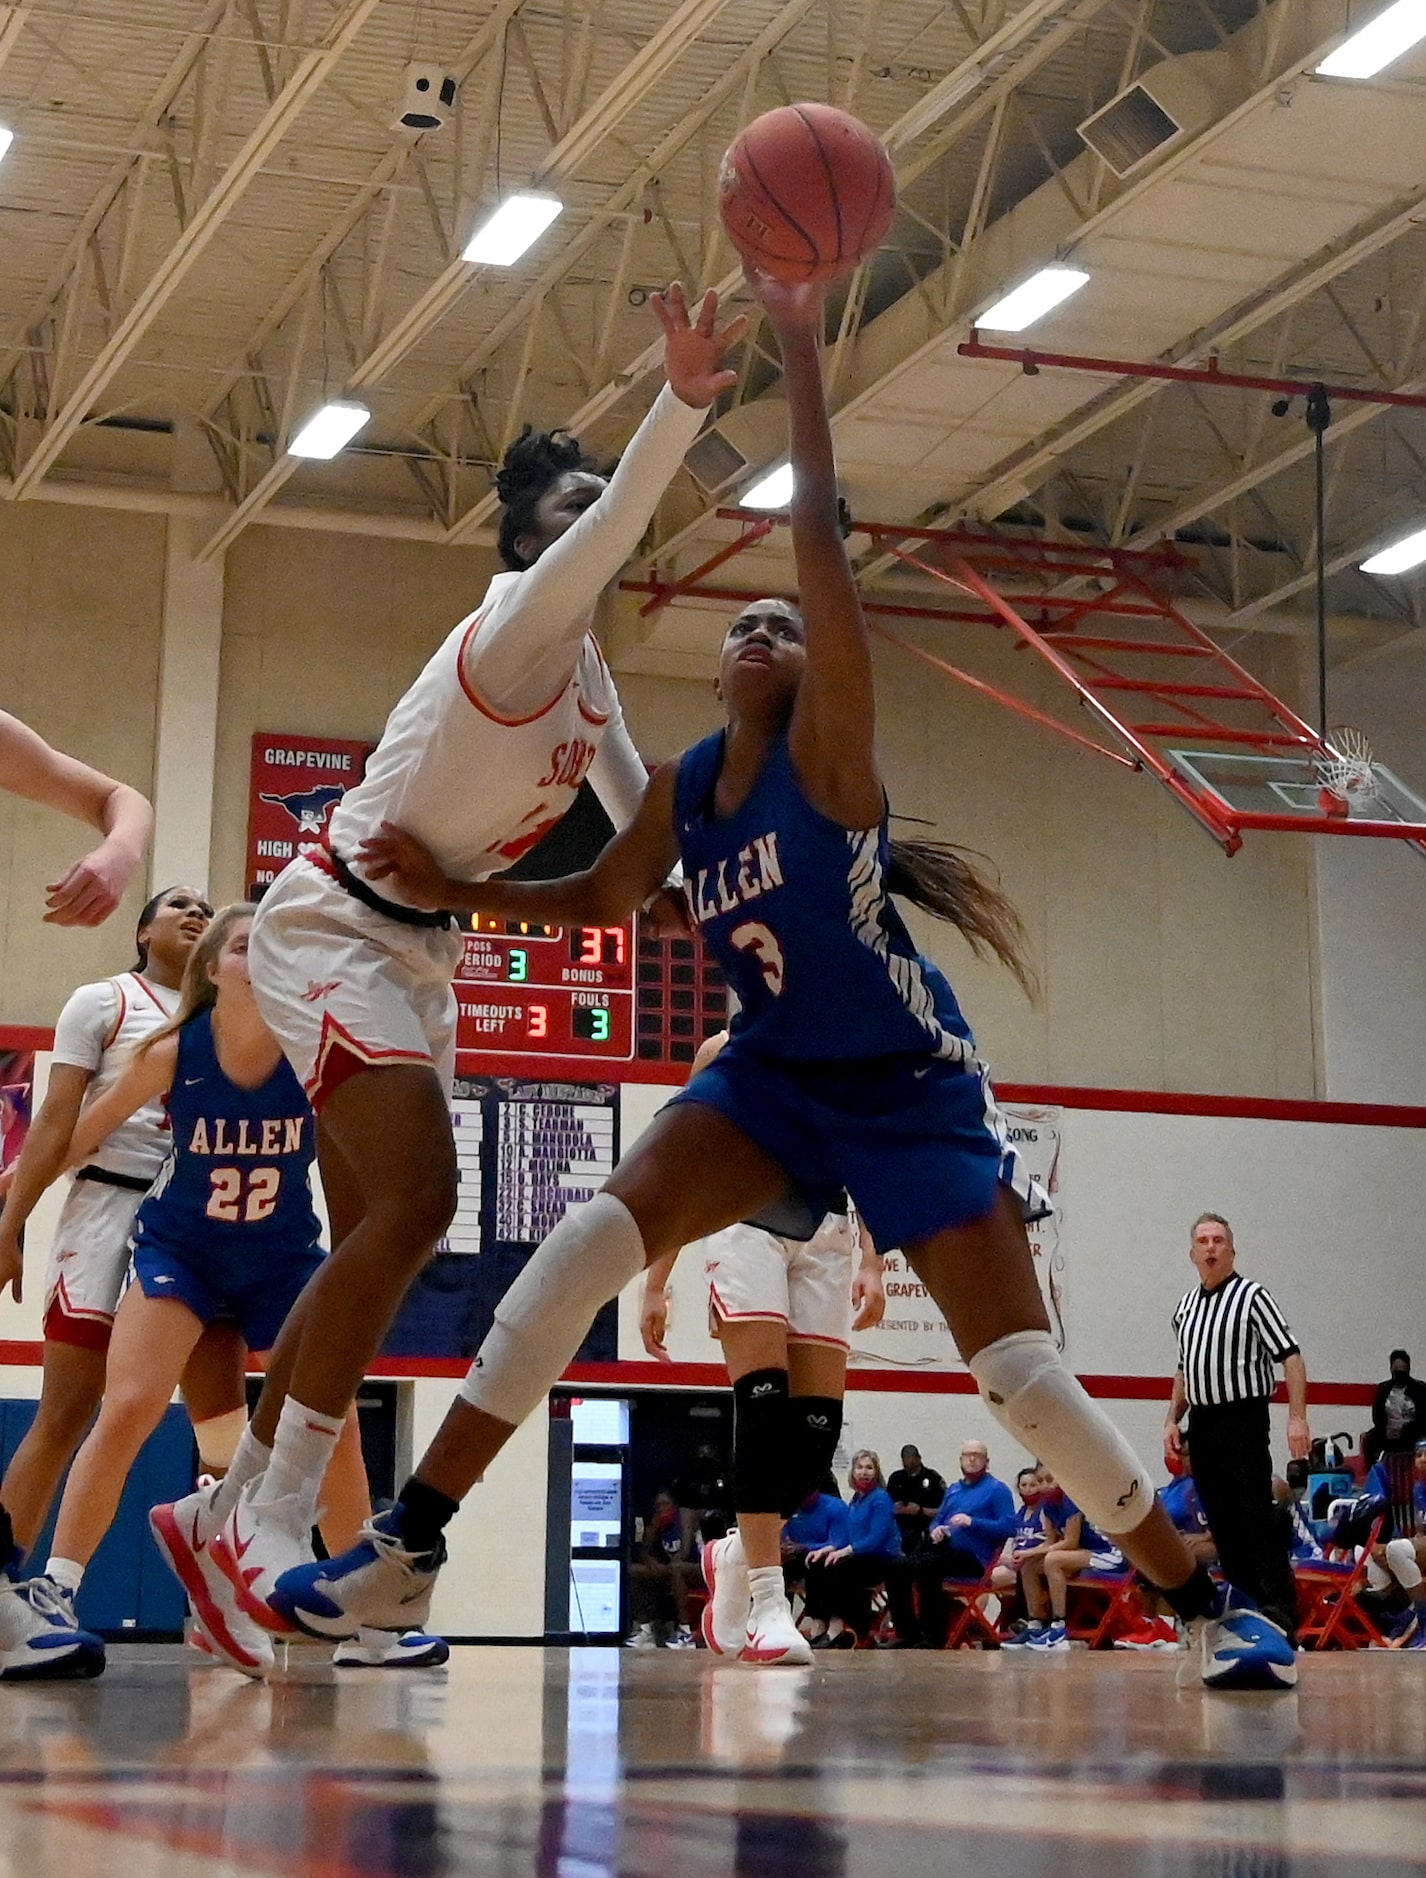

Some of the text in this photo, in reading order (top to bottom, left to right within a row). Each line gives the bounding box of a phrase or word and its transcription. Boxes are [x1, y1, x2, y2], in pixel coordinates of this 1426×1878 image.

[265, 748, 352, 771] GRAPEVINE
[257, 840, 293, 858] HIGH
[467, 940, 492, 952] POSS
[579, 926, 625, 964] 37
[464, 952, 502, 967] ERIOD
[508, 949, 527, 981] 3
[731, 920, 785, 998] 3
[561, 968, 604, 983] BONUS
[571, 992, 610, 1007] FOULS
[459, 1002, 523, 1019] TIMEOUTS
[475, 1018, 506, 1034] LEFT
[528, 1005, 548, 1037] 3
[590, 1008, 610, 1041] 3
[189, 1116, 305, 1156] ALLEN
[501, 1145, 513, 1157] 10
[205, 1166, 282, 1222] 22
